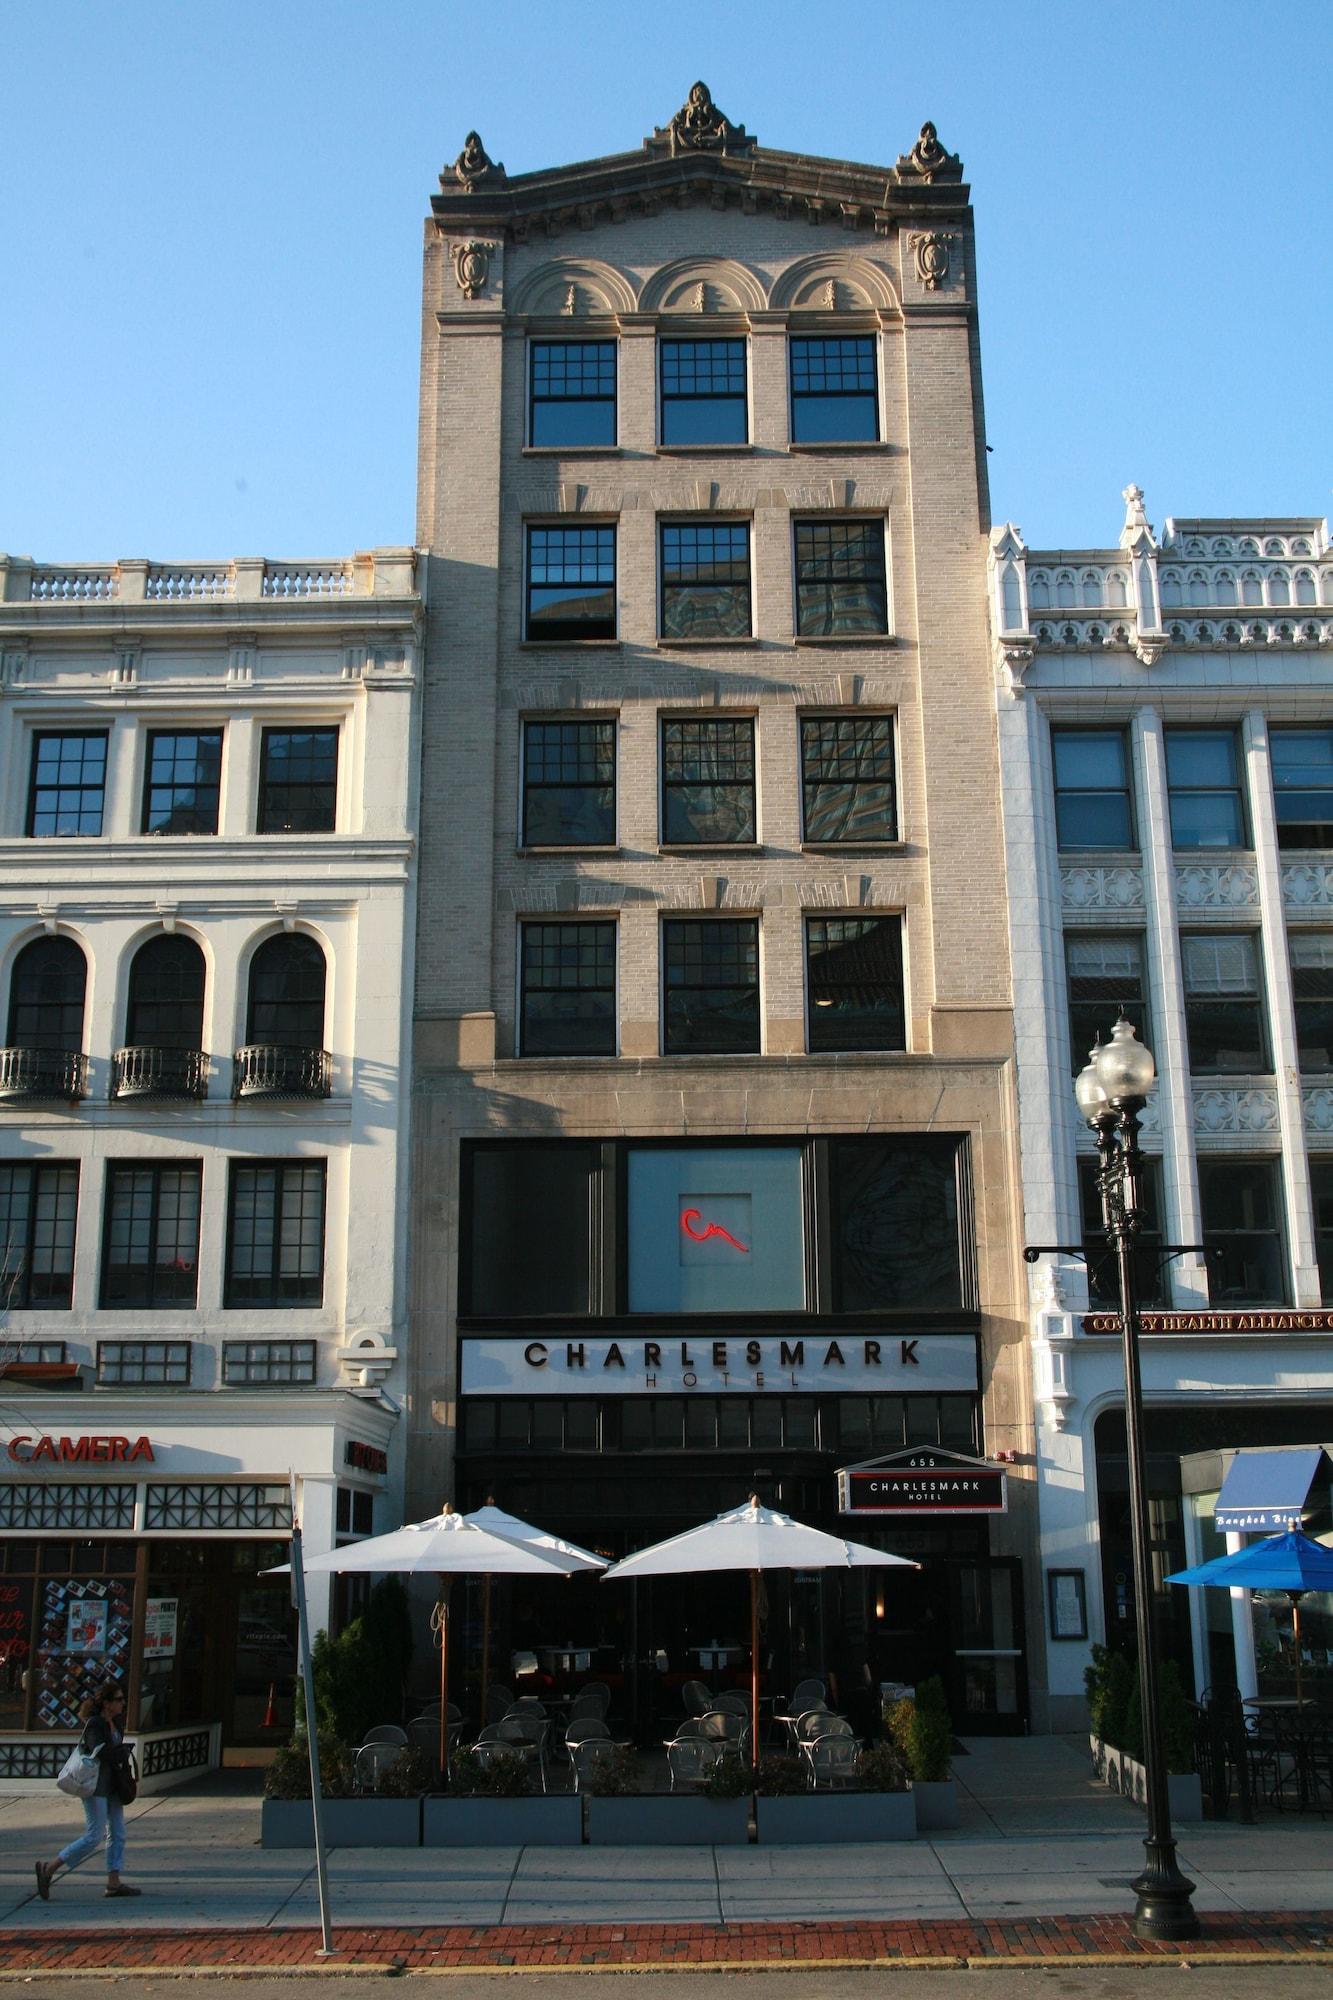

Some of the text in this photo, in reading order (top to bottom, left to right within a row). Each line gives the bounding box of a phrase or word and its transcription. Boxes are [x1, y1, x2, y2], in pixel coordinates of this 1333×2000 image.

[1162, 1315, 1233, 1330] HEALTH
[1237, 1314, 1324, 1329] ALLIANCE
[524, 1340, 920, 1367] CHARLESMARK
[646, 1372, 799, 1388] HOTEL
[8, 1436, 155, 1462] CAMERA
[910, 1458, 935, 1467] 655
[870, 1482, 980, 1491] CHARLESMARK
[909, 1493, 942, 1501] HOTEL
[1216, 1514, 1266, 1527] Bangkok
